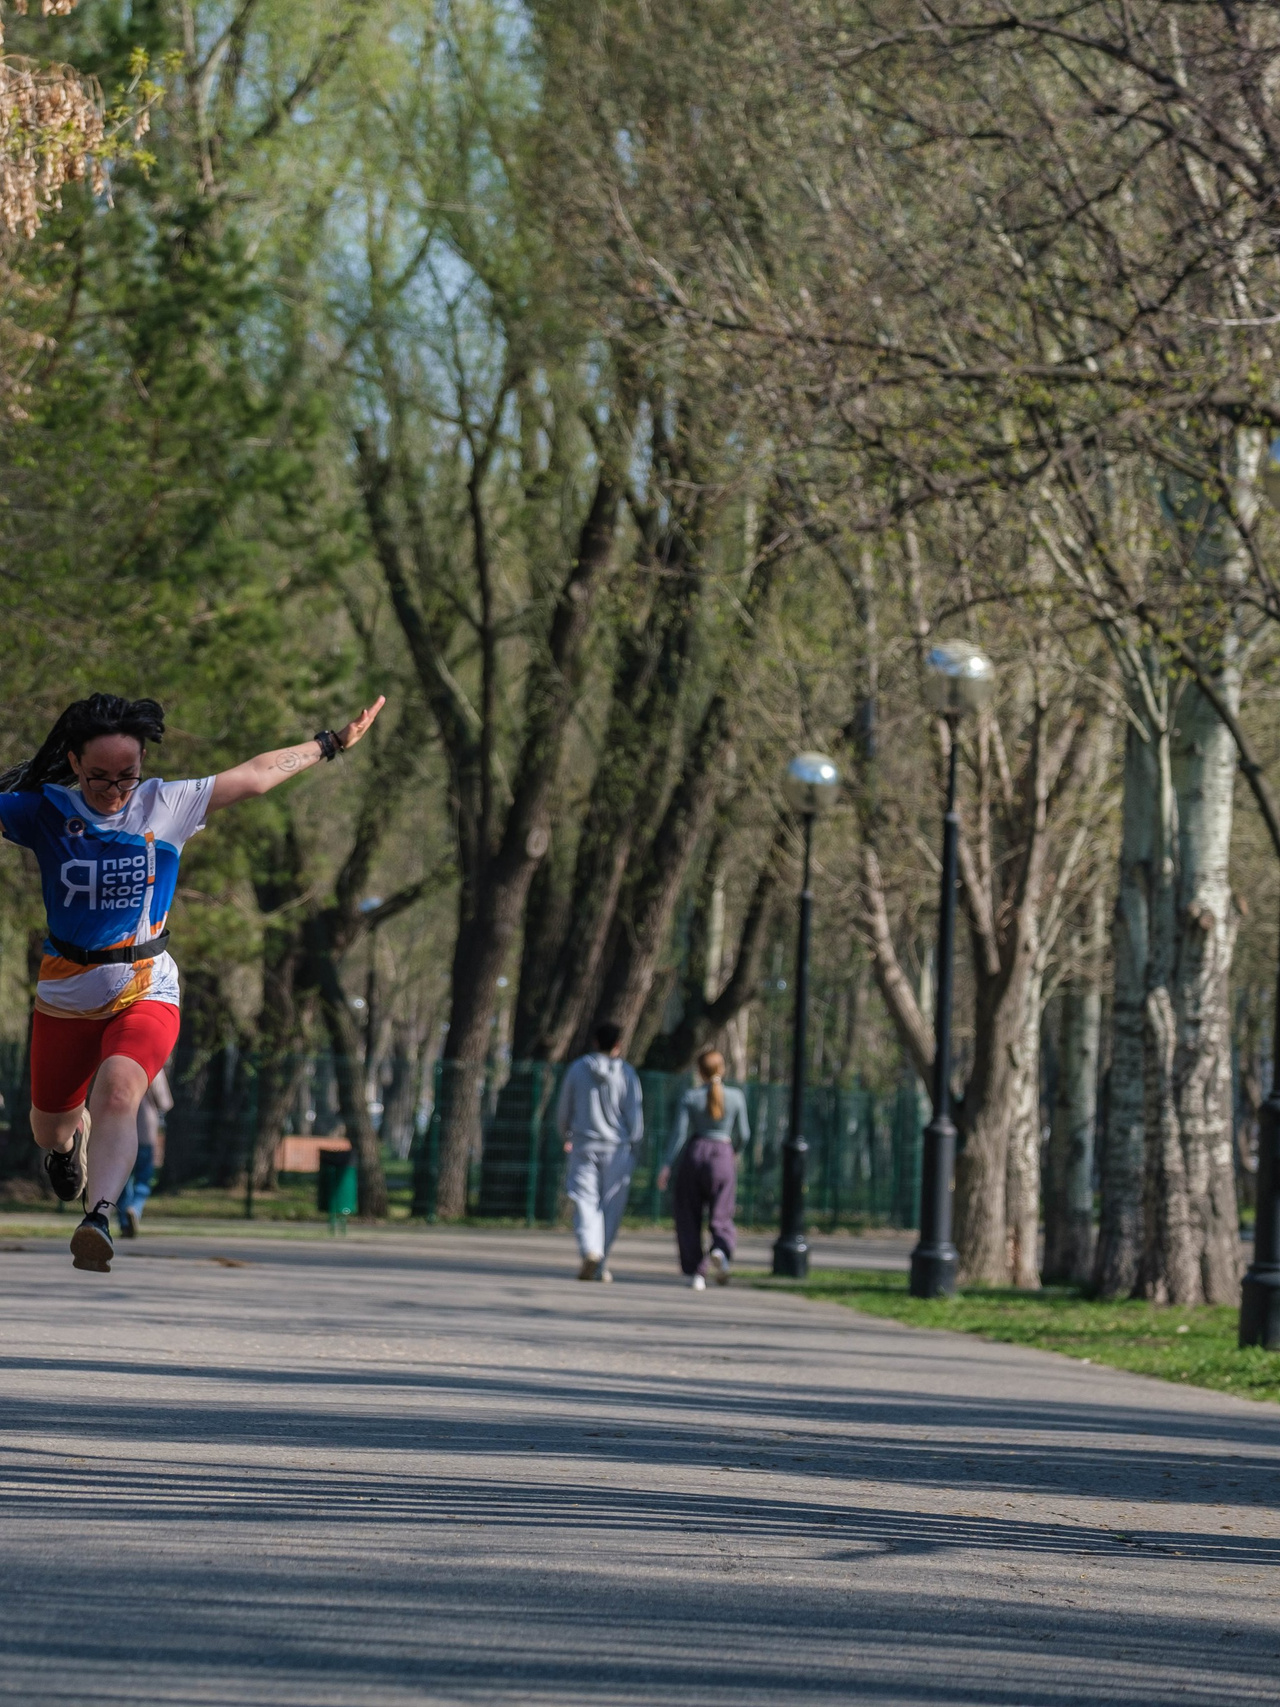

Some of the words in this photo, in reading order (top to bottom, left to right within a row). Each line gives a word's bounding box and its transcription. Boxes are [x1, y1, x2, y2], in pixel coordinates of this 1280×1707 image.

[102, 855, 146, 871] ПРО
[60, 859, 97, 910] Я
[102, 869, 146, 885] СТО
[102, 883, 144, 897] КОС
[100, 897, 142, 910] МОС
